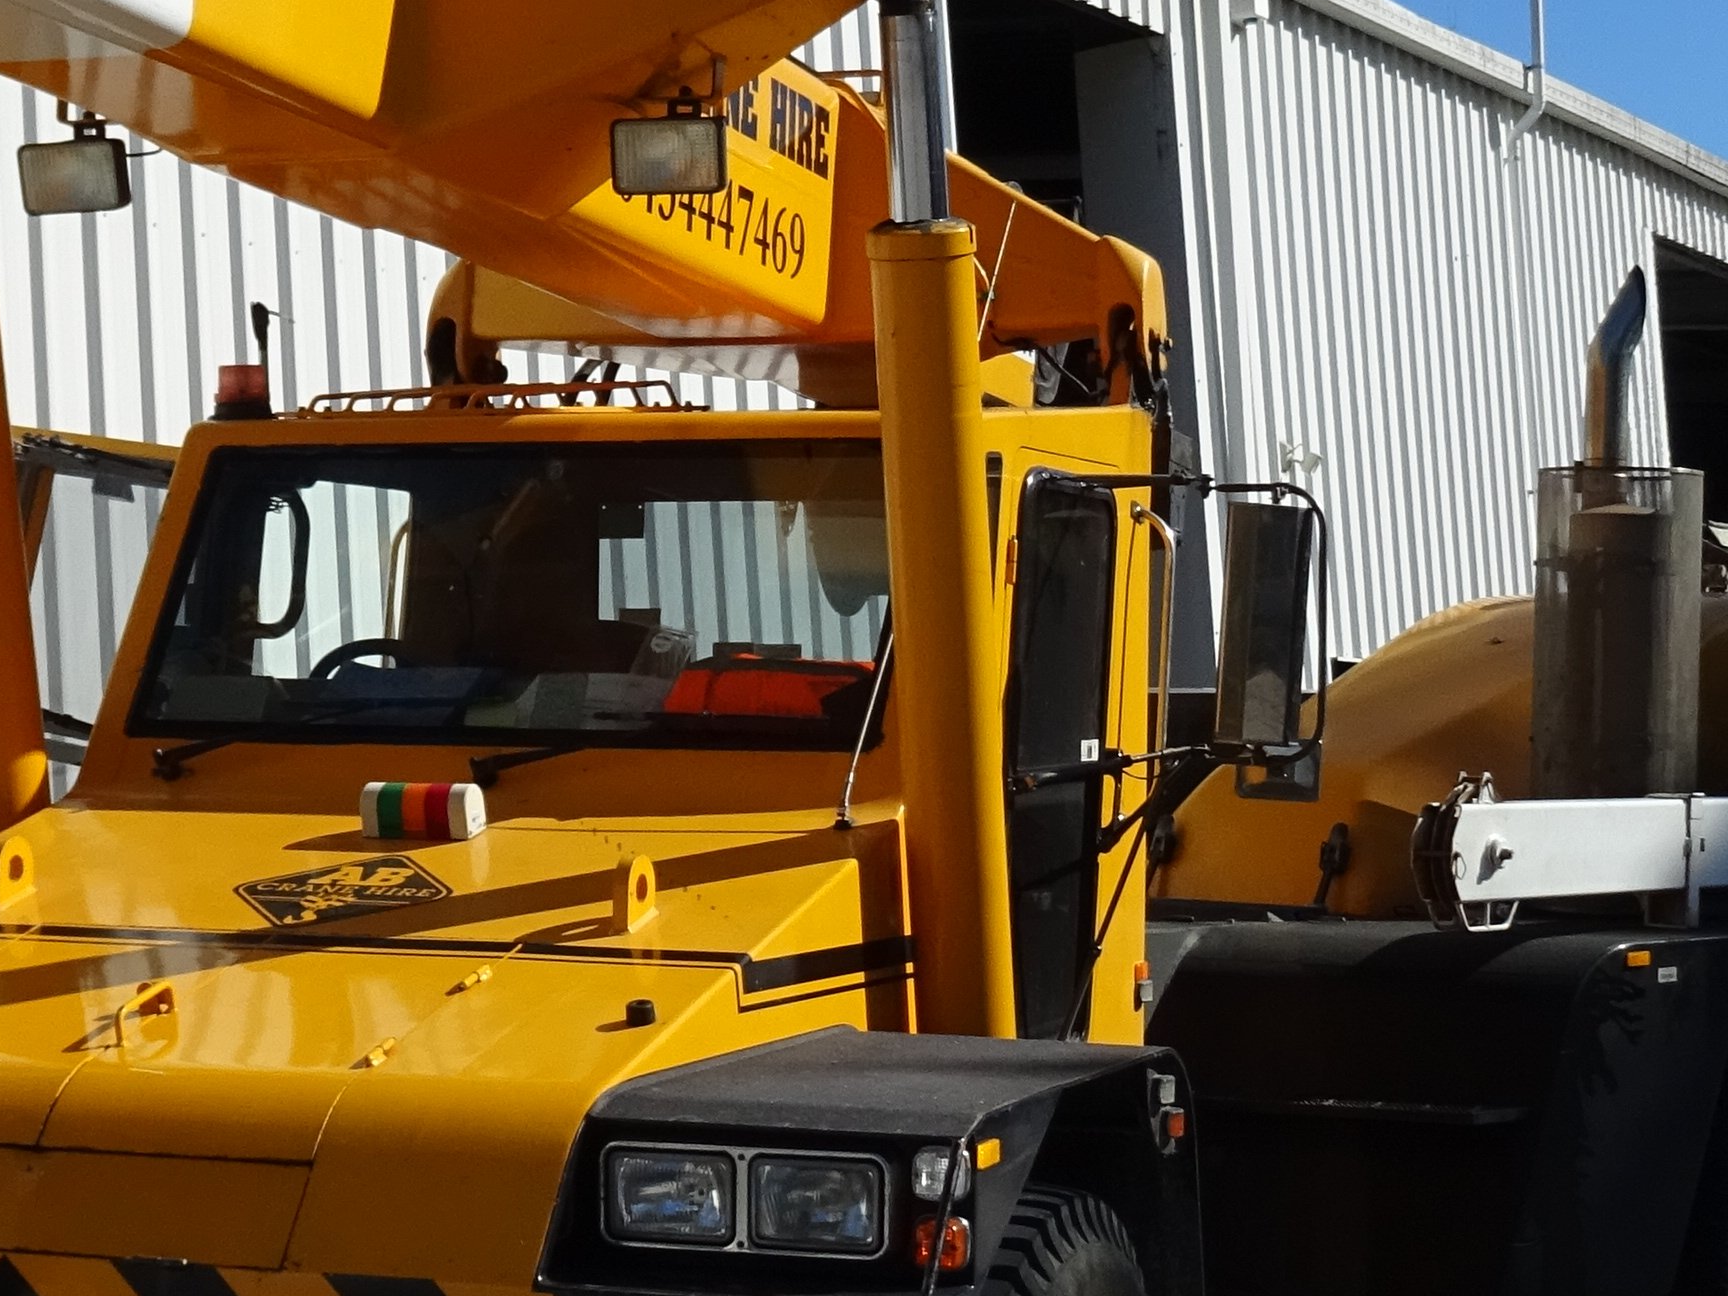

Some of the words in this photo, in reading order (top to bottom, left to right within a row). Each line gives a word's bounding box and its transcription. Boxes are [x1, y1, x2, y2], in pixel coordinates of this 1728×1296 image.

[770, 77, 831, 181] HIRE
[306, 865, 416, 887] AB
[257, 881, 358, 897] CRANE
[363, 885, 438, 899] HIRE
